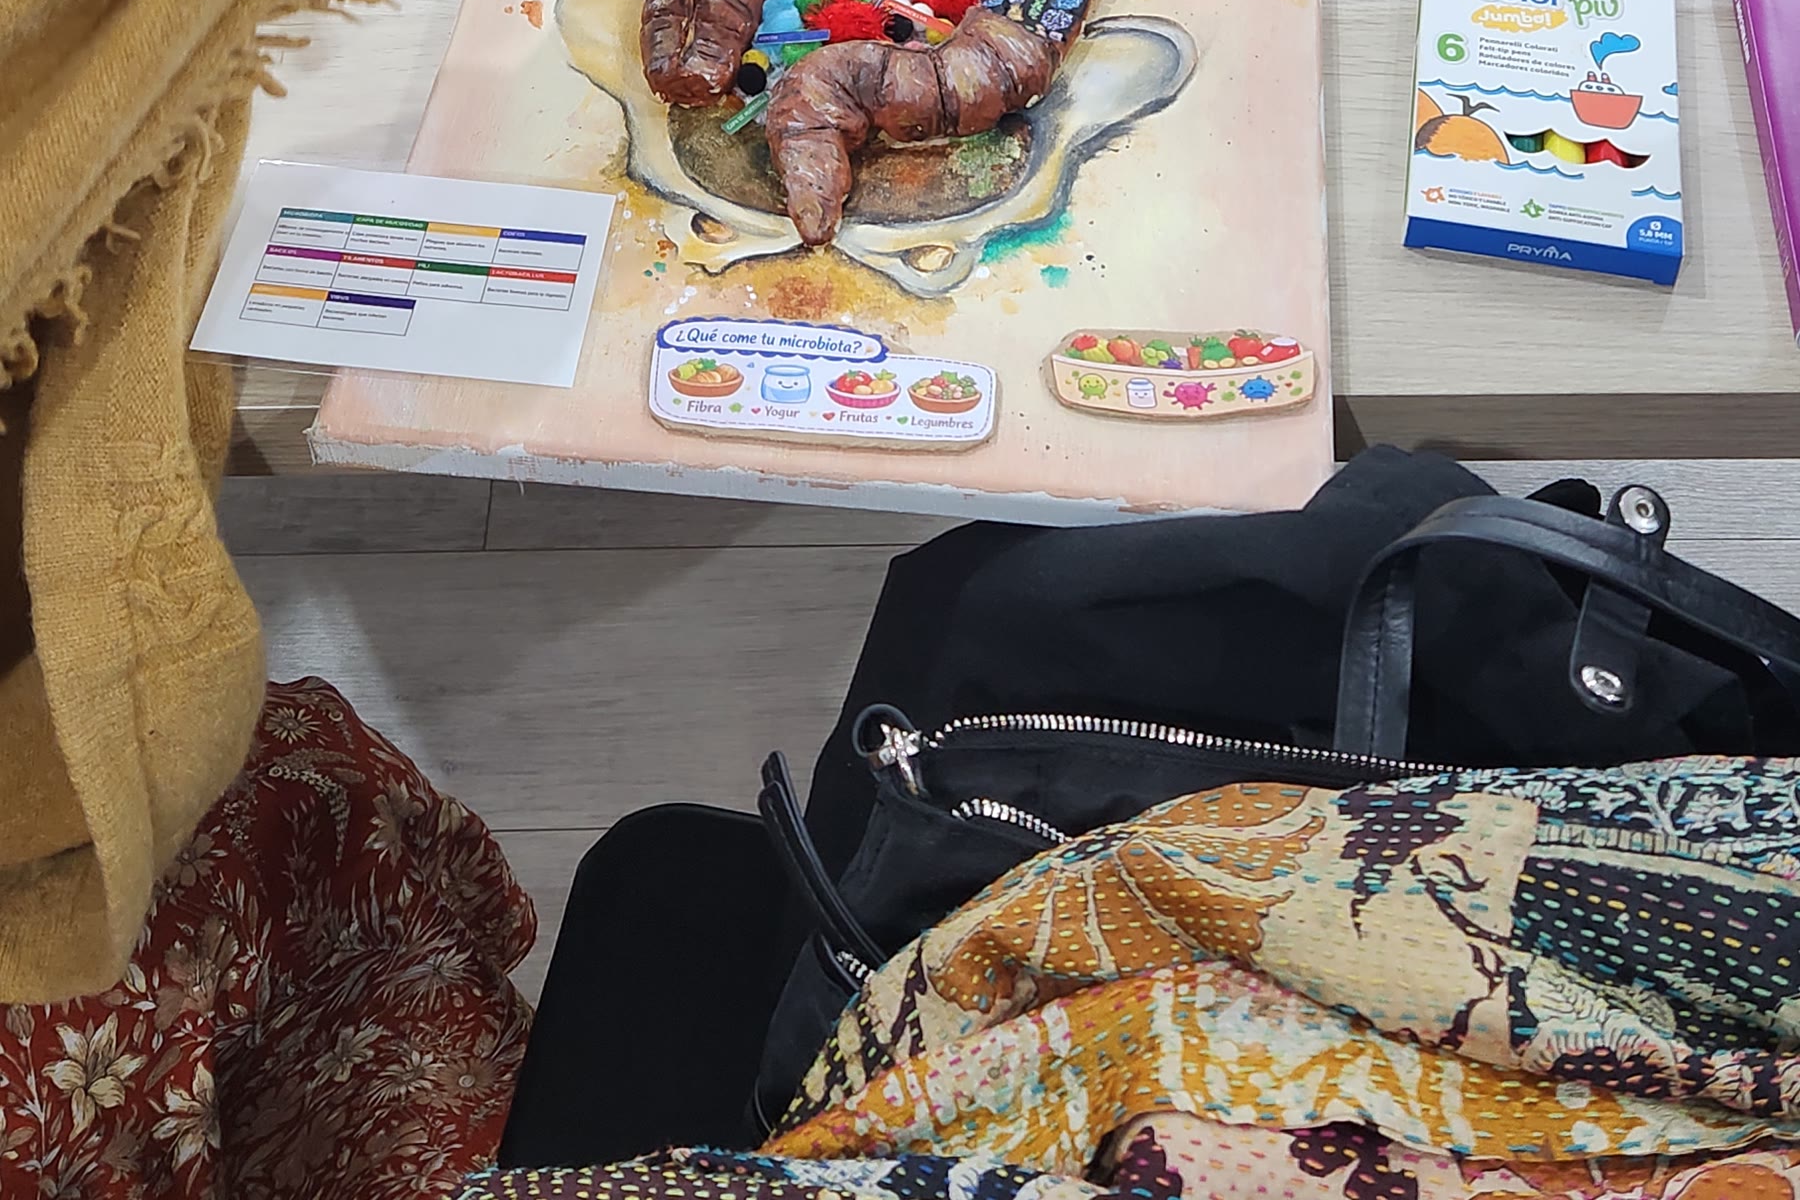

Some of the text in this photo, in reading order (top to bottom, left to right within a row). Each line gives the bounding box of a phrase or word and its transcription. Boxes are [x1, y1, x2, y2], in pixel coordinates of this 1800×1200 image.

[1479, 10, 1551, 27] Jumbo!
[1437, 33, 1466, 62] 6
[1479, 44, 1531, 57] Felt-tip pens
[1480, 37, 1558, 52] Pennarelli Colorati
[1478, 60, 1528, 72] Marcadores
[1479, 52, 1530, 64] Rotuladores
[1544, 61, 1576, 71] colores
[675, 327, 863, 355] ¿Qué come tu microbiota?
[687, 400, 722, 414] Fibra
[764, 405, 800, 420] Yogur
[839, 410, 879, 424] Frutas
[910, 415, 974, 430] Legumbres
